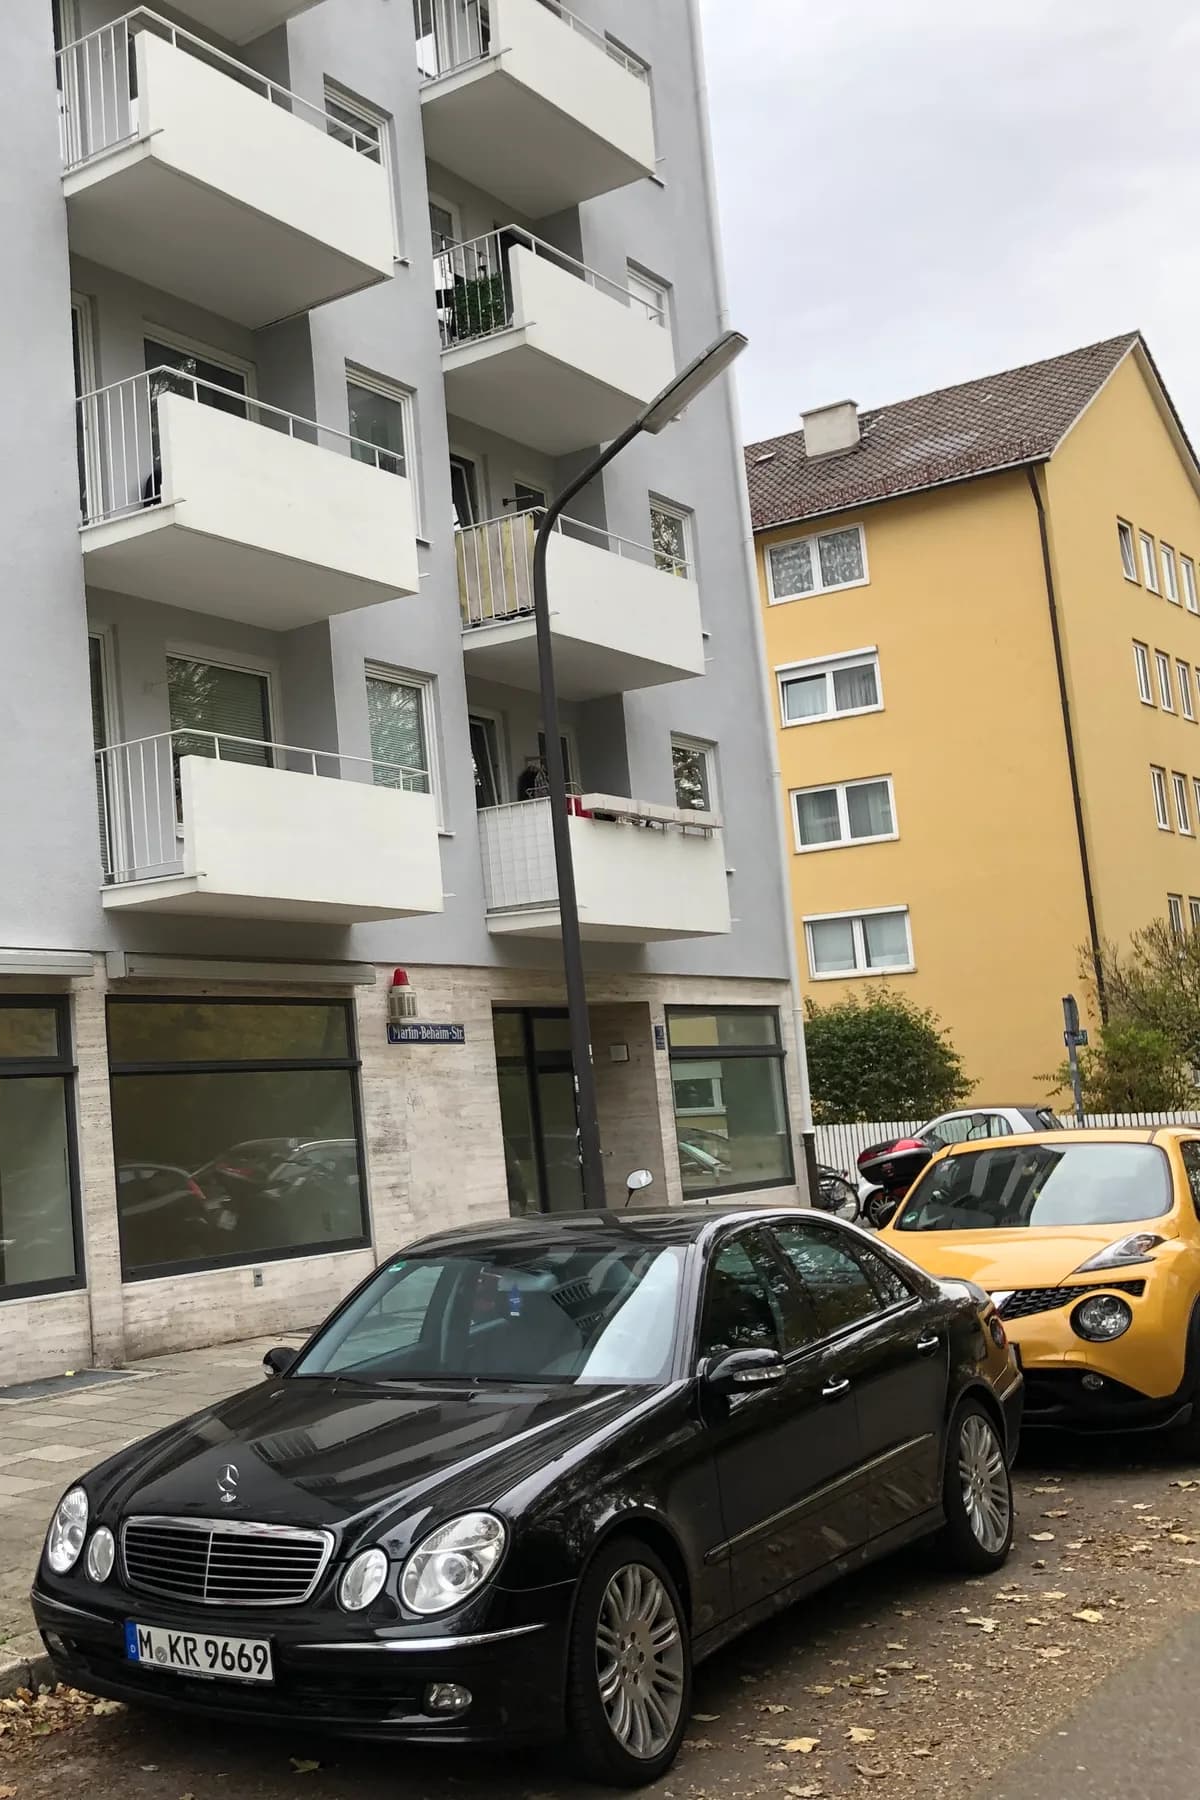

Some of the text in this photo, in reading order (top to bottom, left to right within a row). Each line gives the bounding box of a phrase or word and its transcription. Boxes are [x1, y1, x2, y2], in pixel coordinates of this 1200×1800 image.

[138, 1628, 268, 1674] M KR 9669
